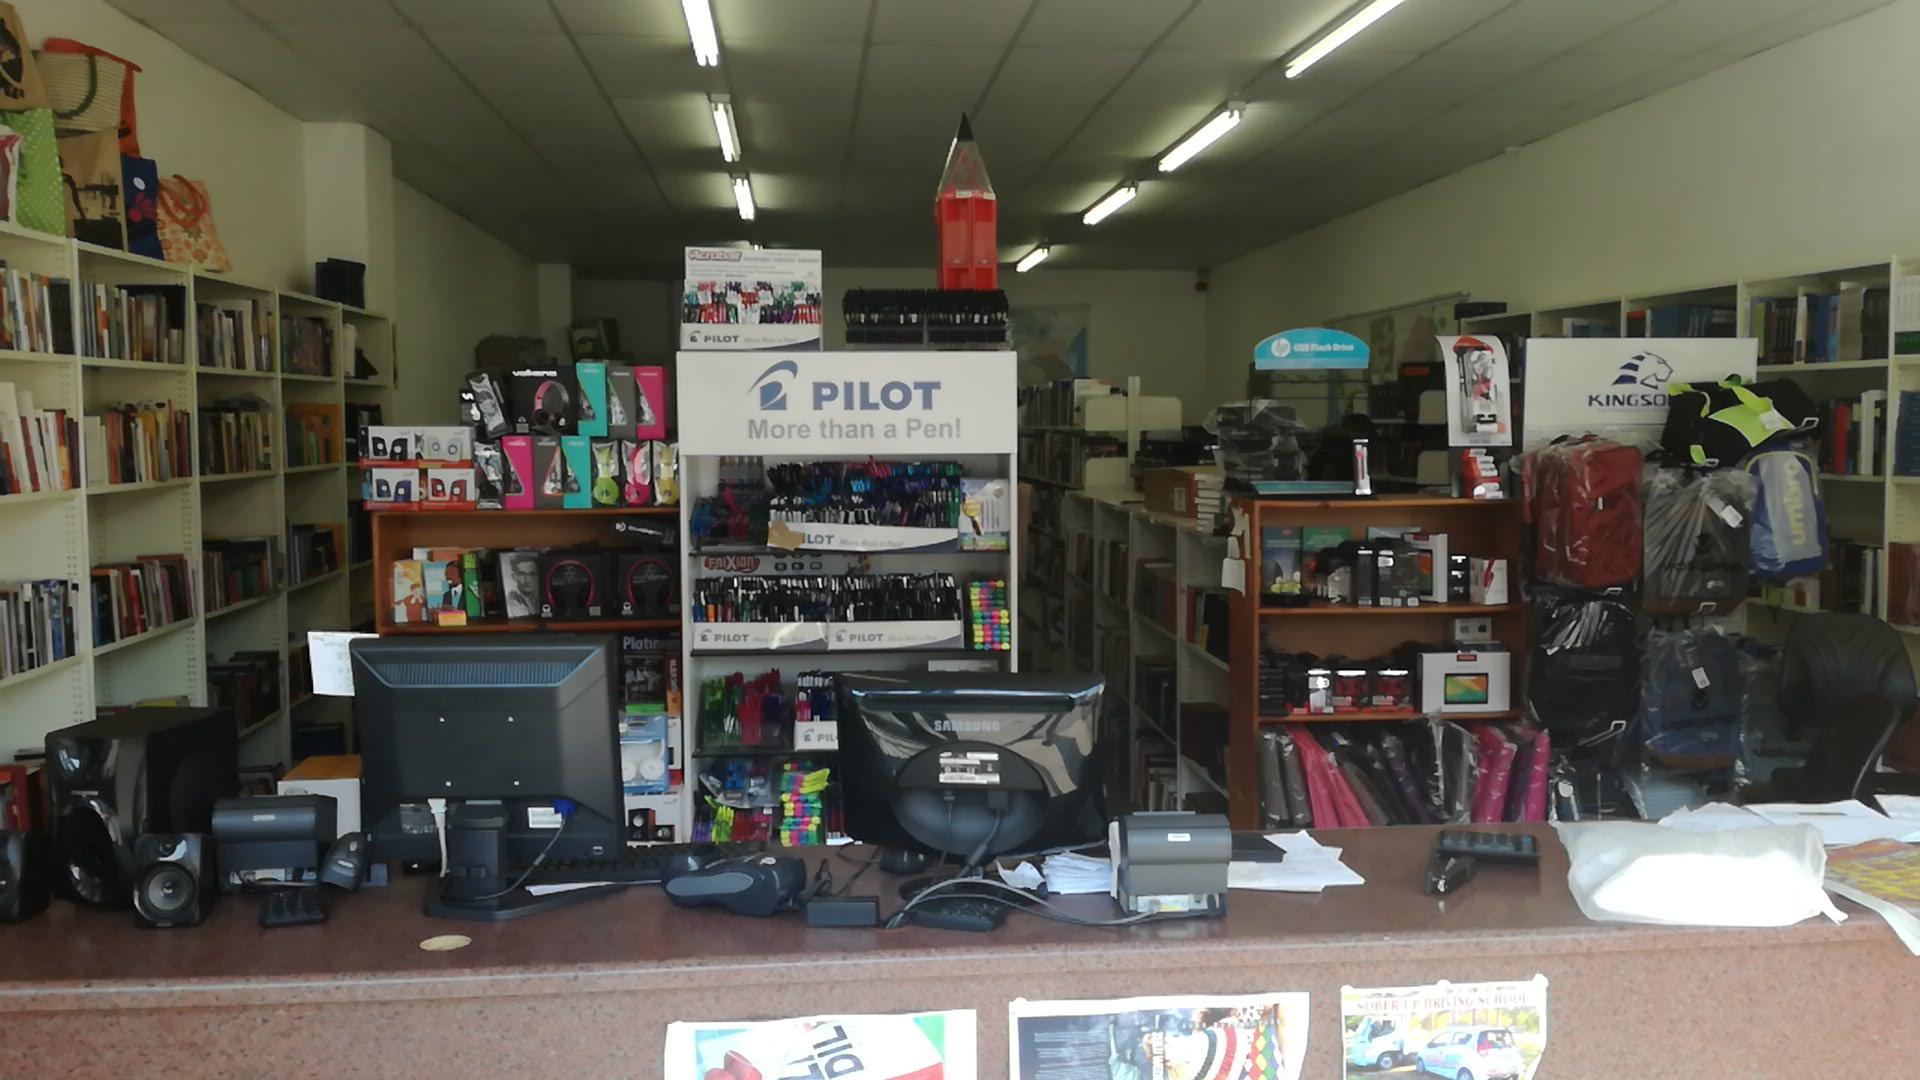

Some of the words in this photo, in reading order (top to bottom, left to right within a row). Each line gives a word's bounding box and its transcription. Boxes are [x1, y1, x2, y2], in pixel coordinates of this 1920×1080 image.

[704, 335, 739, 343] PILOT
[1311, 343, 1332, 352] Flash
[1333, 343, 1354, 352] Drive
[812, 381, 941, 411] PILOT
[1588, 394, 1670, 407] KINGSO
[747, 419, 811, 439] More
[819, 418, 875, 439] than
[883, 422, 897, 439] a
[906, 417, 961, 439] Pen!
[805, 534, 834, 545] LOT
[714, 633, 750, 642] PILOT
[849, 633, 884, 642] PILOT
[934, 720, 1000, 732] SAMSUNG
[817, 734, 838, 743] PIL
[1424, 995, 1474, 1010] DRIVING
[1478, 992, 1527, 1006] SCHOOL
